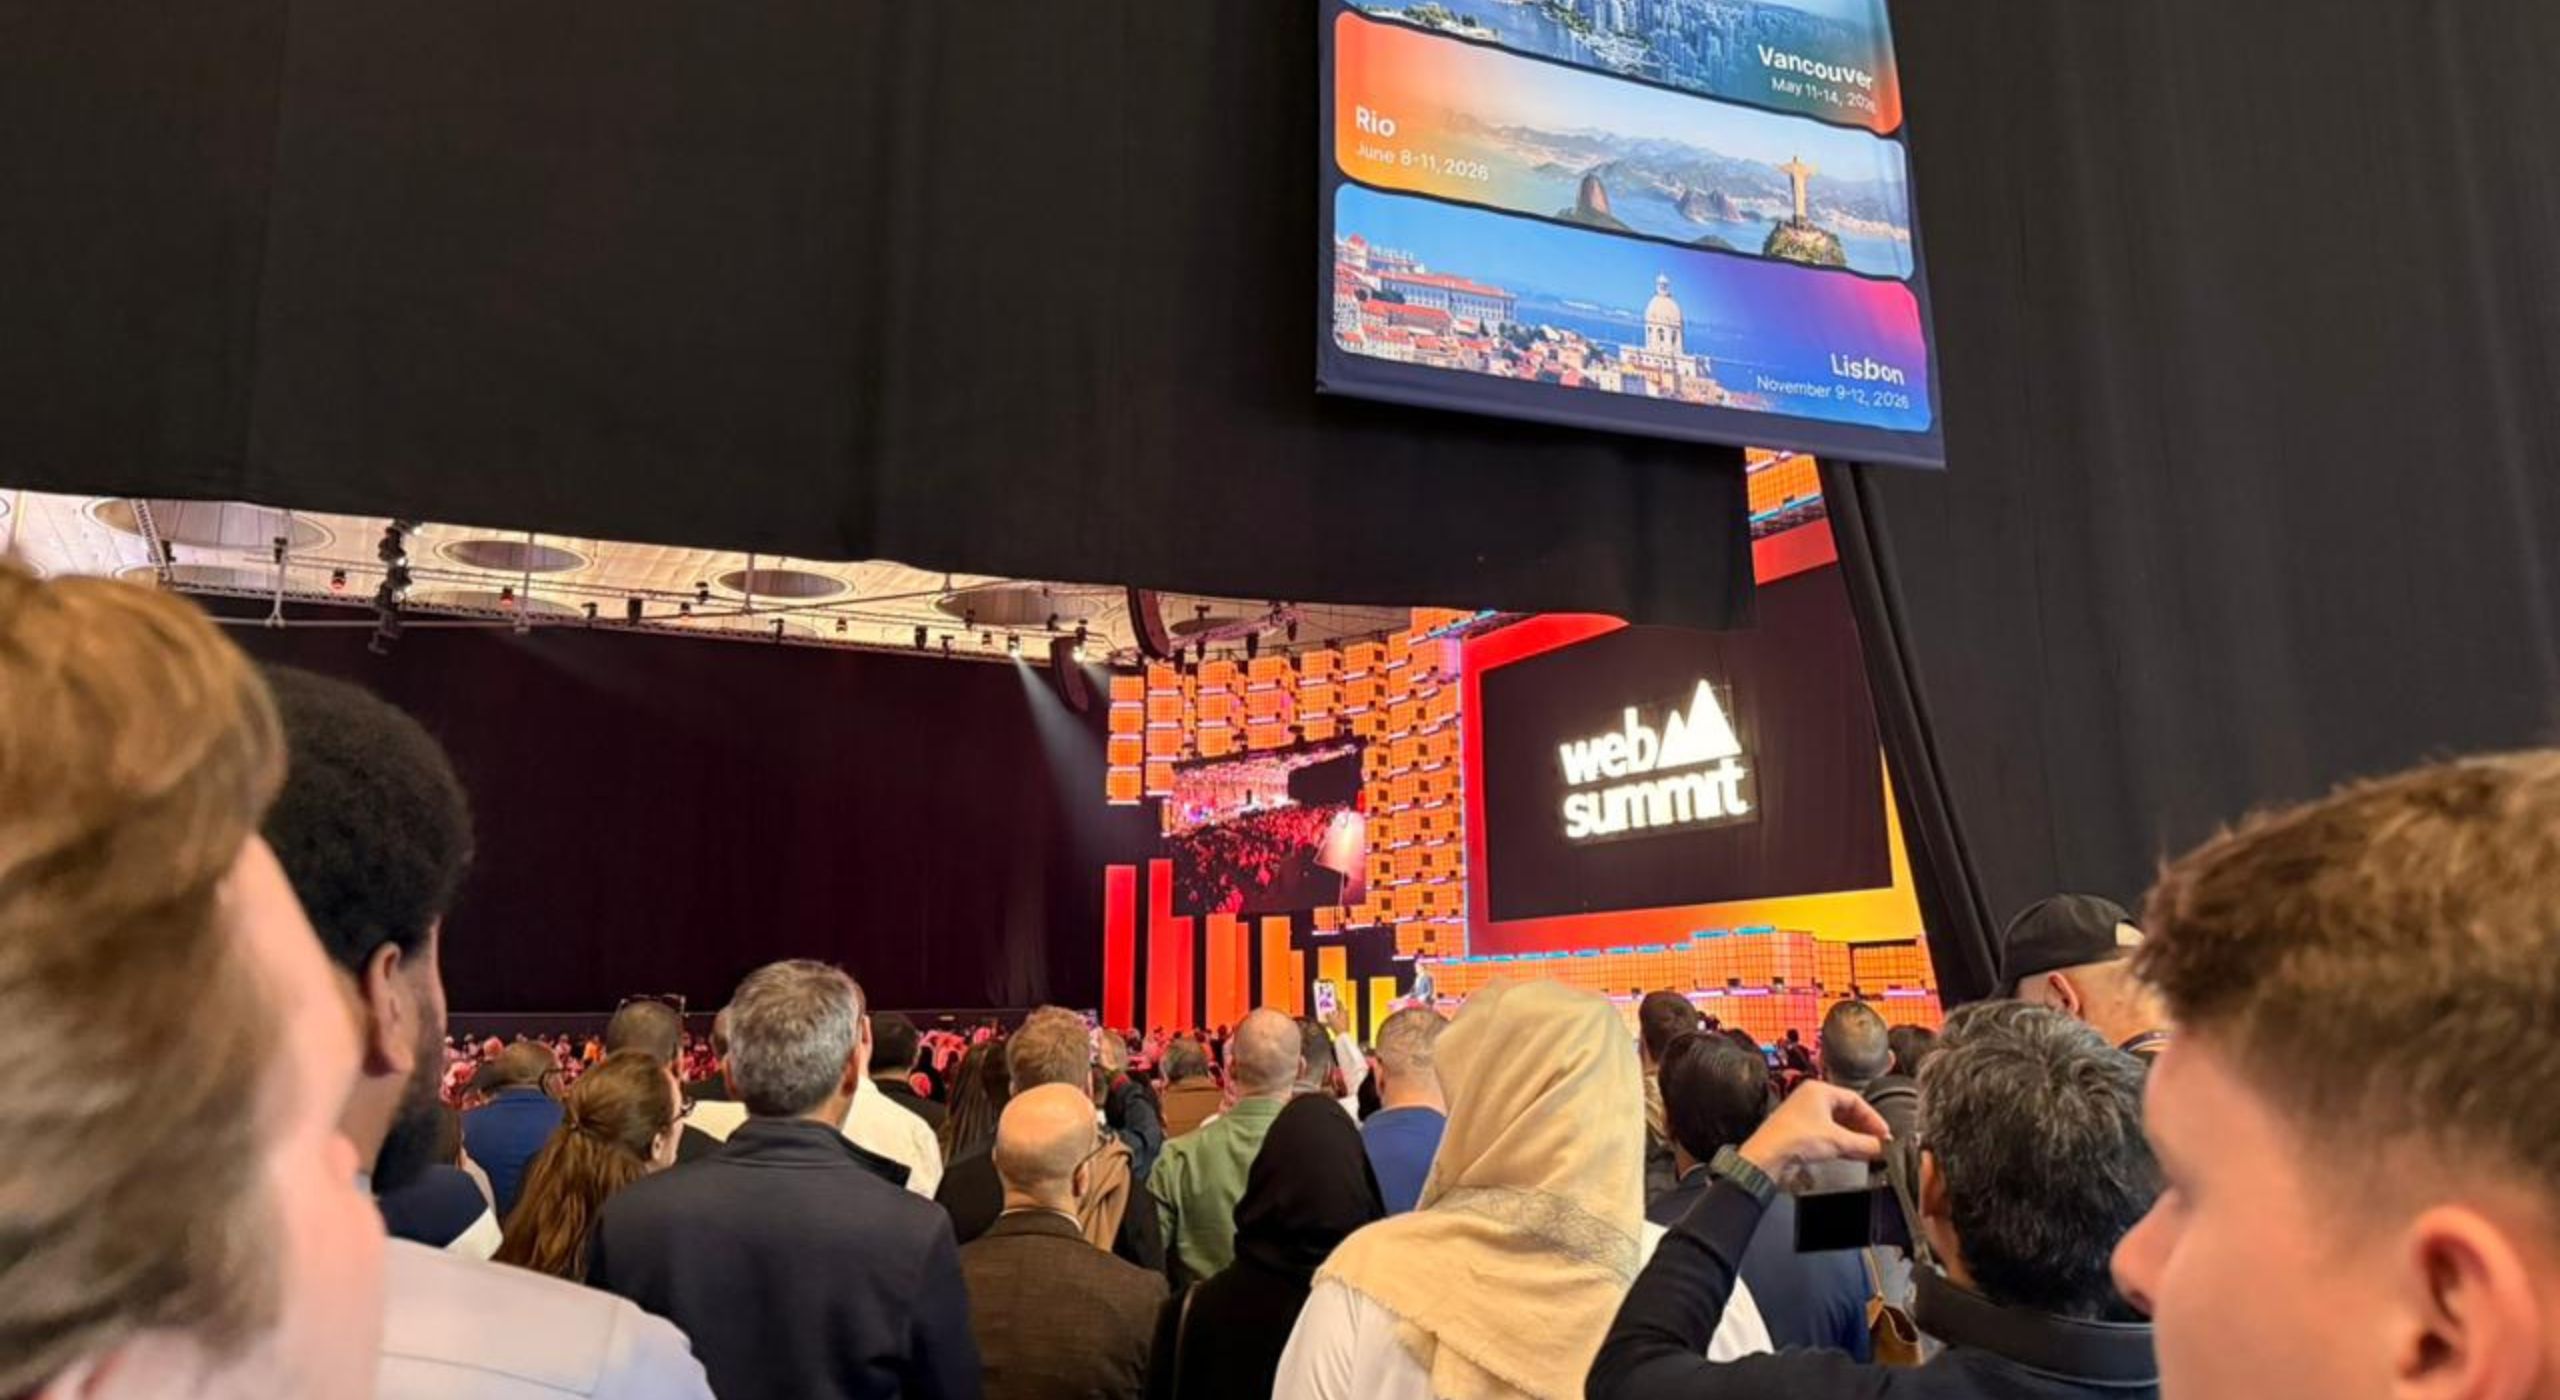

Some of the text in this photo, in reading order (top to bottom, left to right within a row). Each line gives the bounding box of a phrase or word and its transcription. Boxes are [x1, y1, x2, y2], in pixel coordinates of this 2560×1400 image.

[1757, 43, 1873, 91] Vancouver
[1771, 77, 1802, 97] May
[1805, 83, 1843, 107] 11-14,
[1356, 104, 1396, 138] Rio
[1357, 142, 1489, 181] June 8-11, 2026
[1830, 352, 1905, 386] Lisbon
[1756, 375, 1832, 398] November
[1834, 383, 1870, 407] 9-12,
[1559, 706, 1660, 785] web
[1563, 758, 1750, 839] summit
